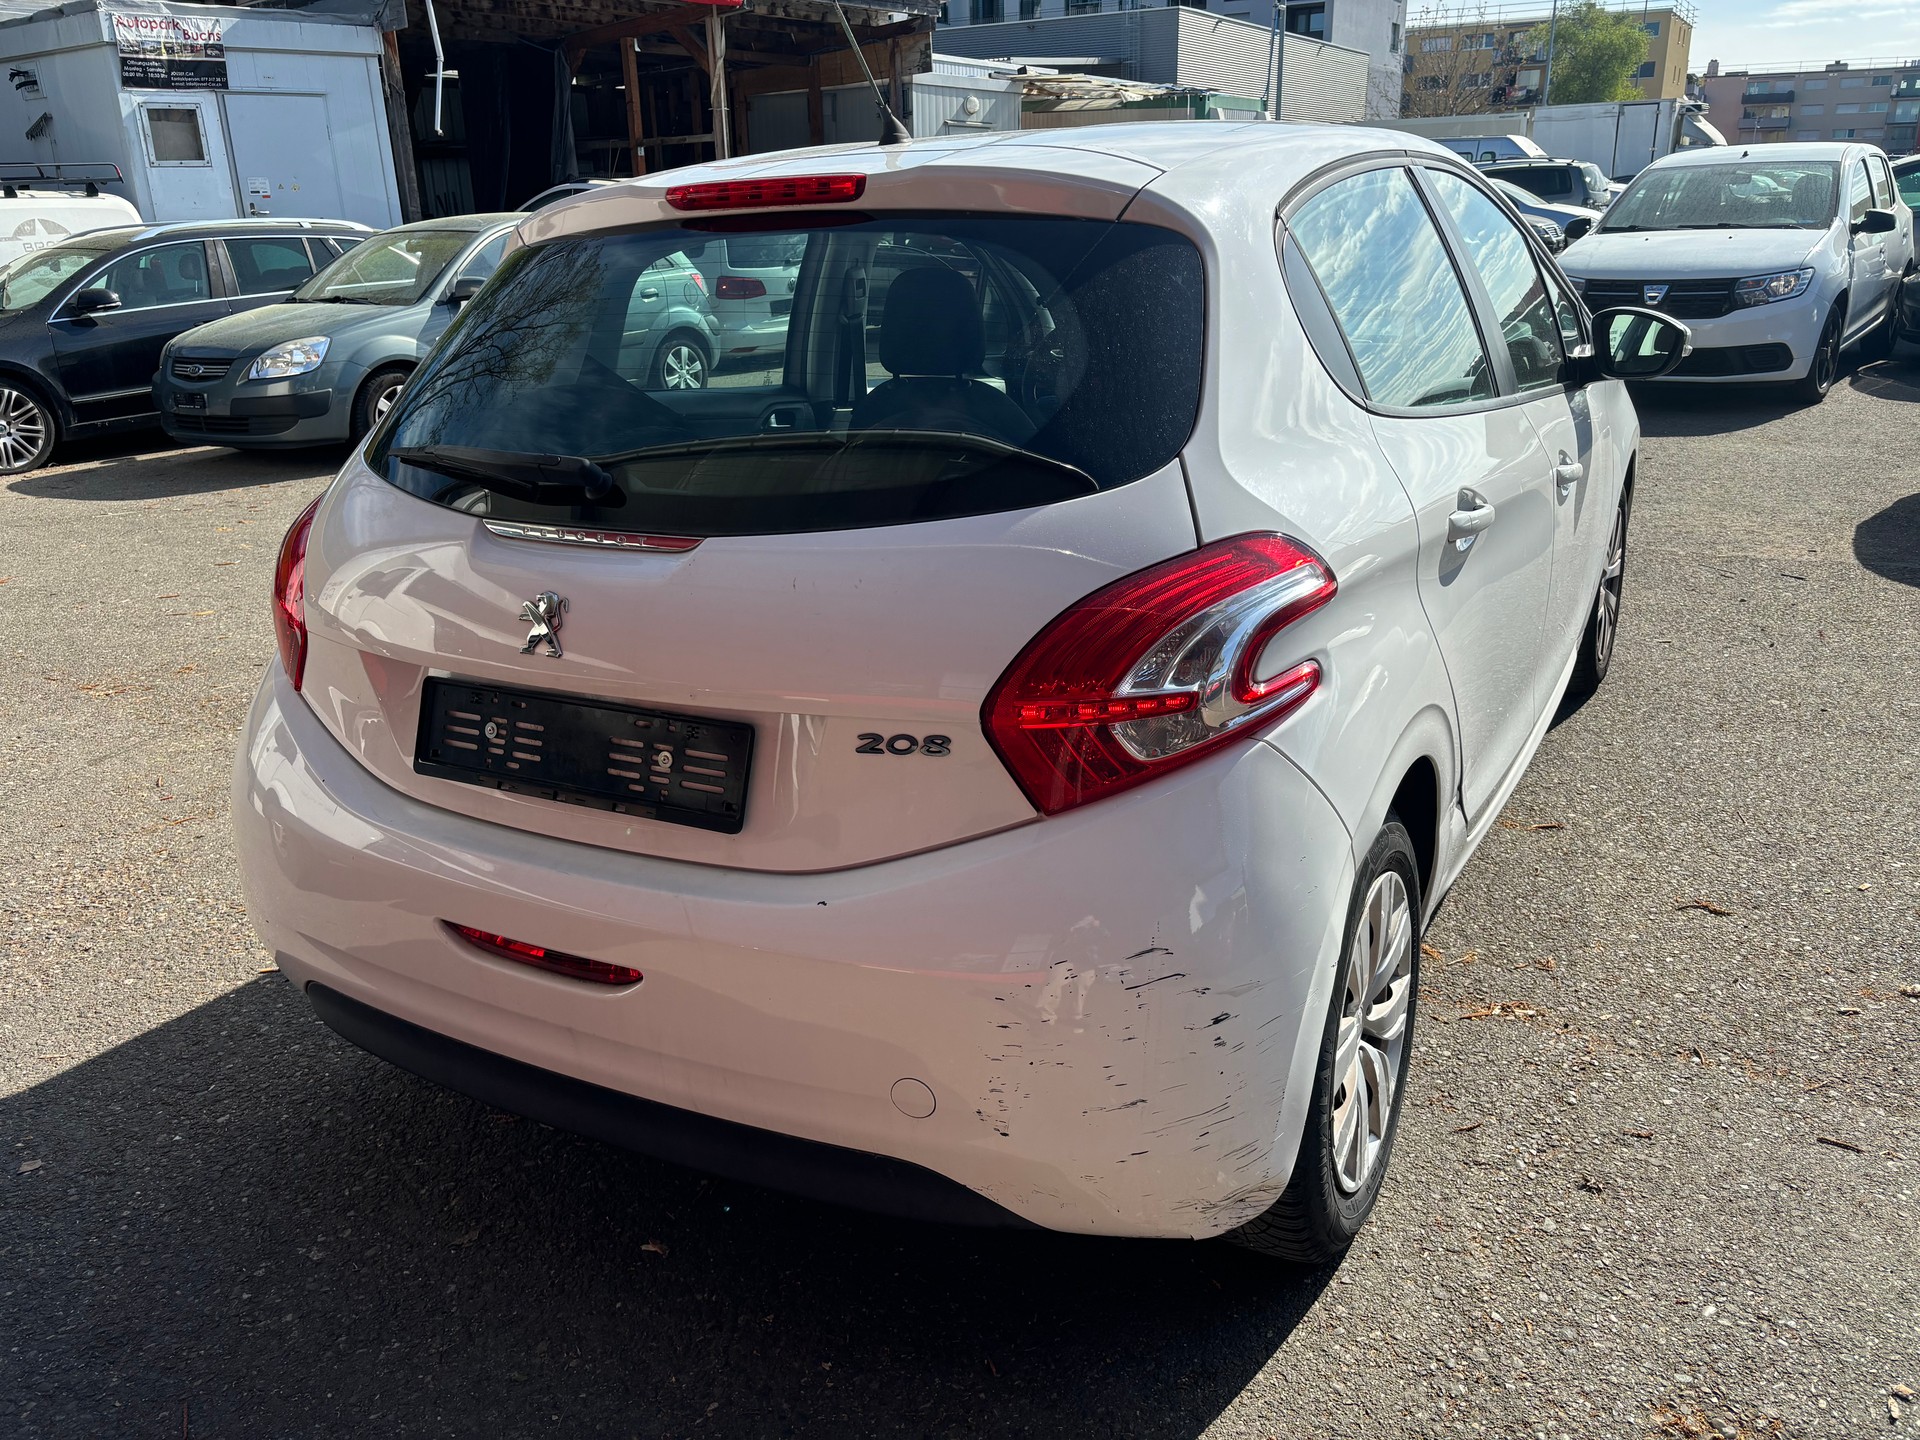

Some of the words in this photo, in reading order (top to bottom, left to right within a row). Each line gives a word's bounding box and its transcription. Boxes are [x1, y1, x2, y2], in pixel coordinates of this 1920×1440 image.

[116, 15, 181, 31] Autopark
[182, 28, 221, 42] Buchs
[522, 526, 647, 547] PEUGEOT
[855, 732, 952, 758] 208
